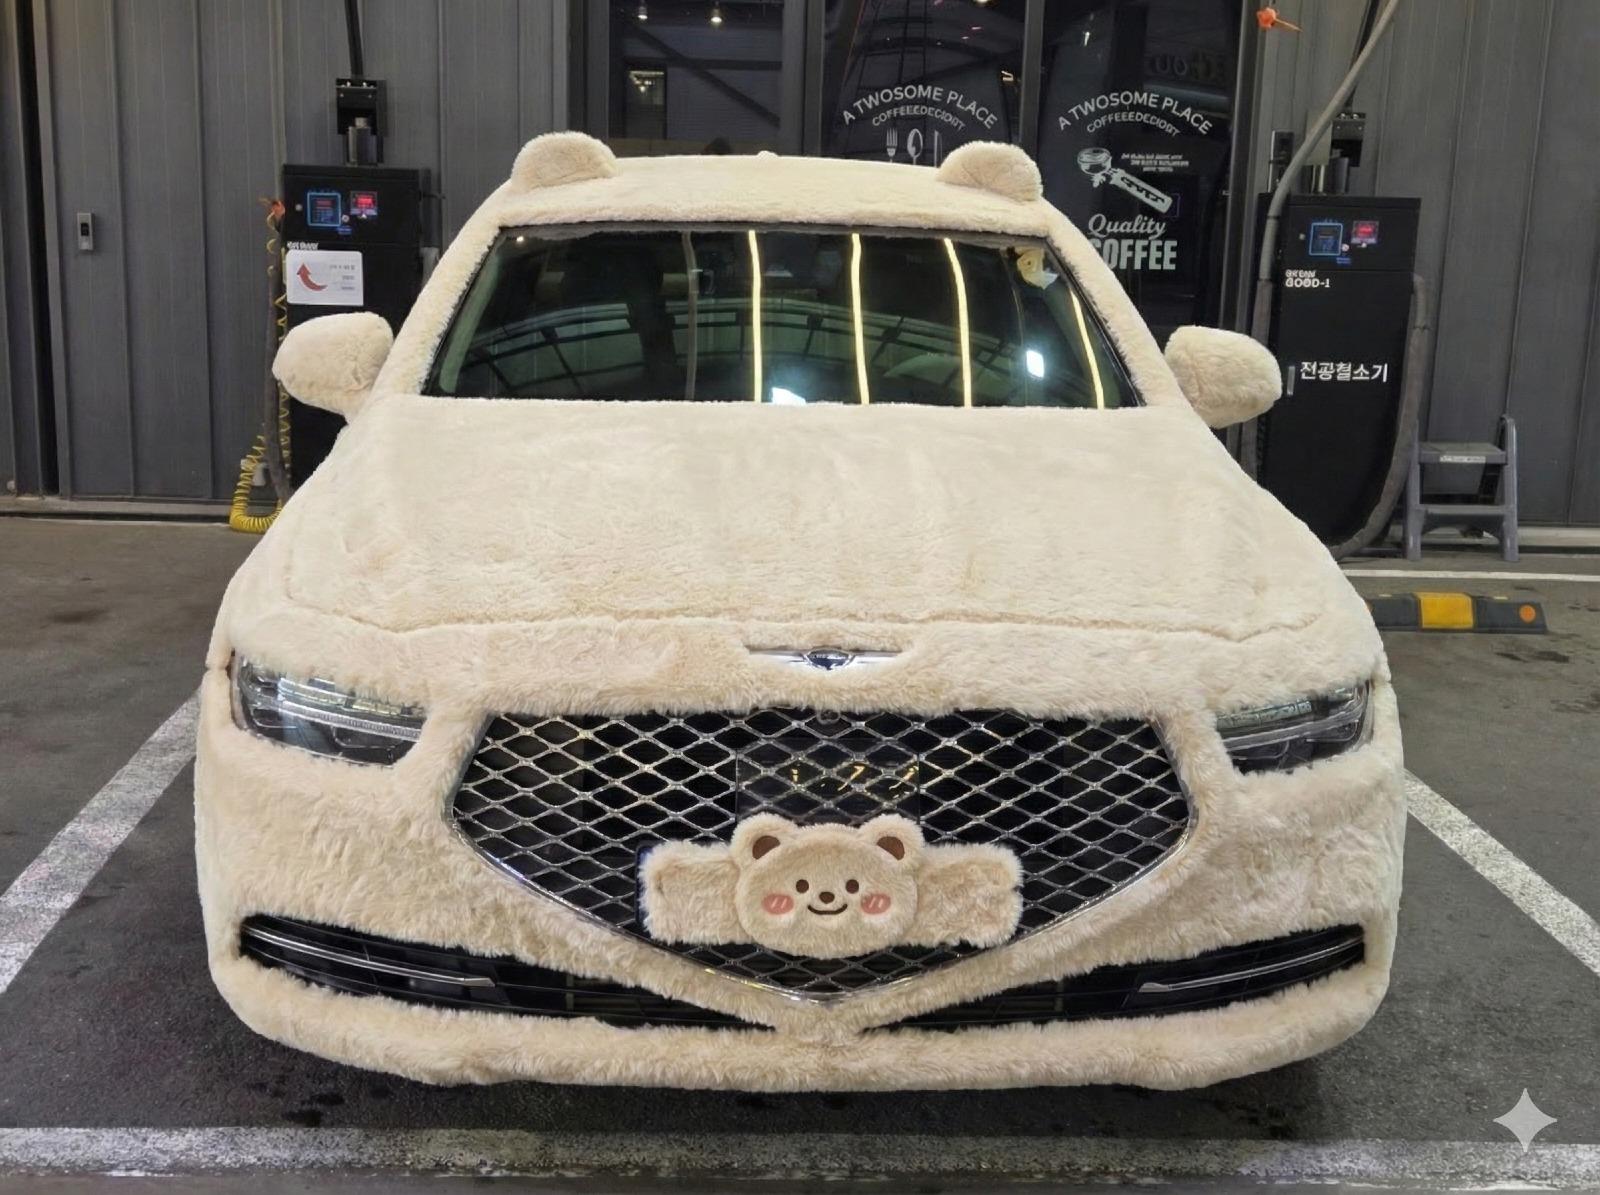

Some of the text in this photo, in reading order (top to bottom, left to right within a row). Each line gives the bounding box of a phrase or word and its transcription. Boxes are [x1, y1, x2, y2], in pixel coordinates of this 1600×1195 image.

[843, 84, 998, 129] A TWOSOME PLACE
[1058, 90, 1213, 135] A TWOSOME PLACE
[1088, 213, 1166, 240] Quality
